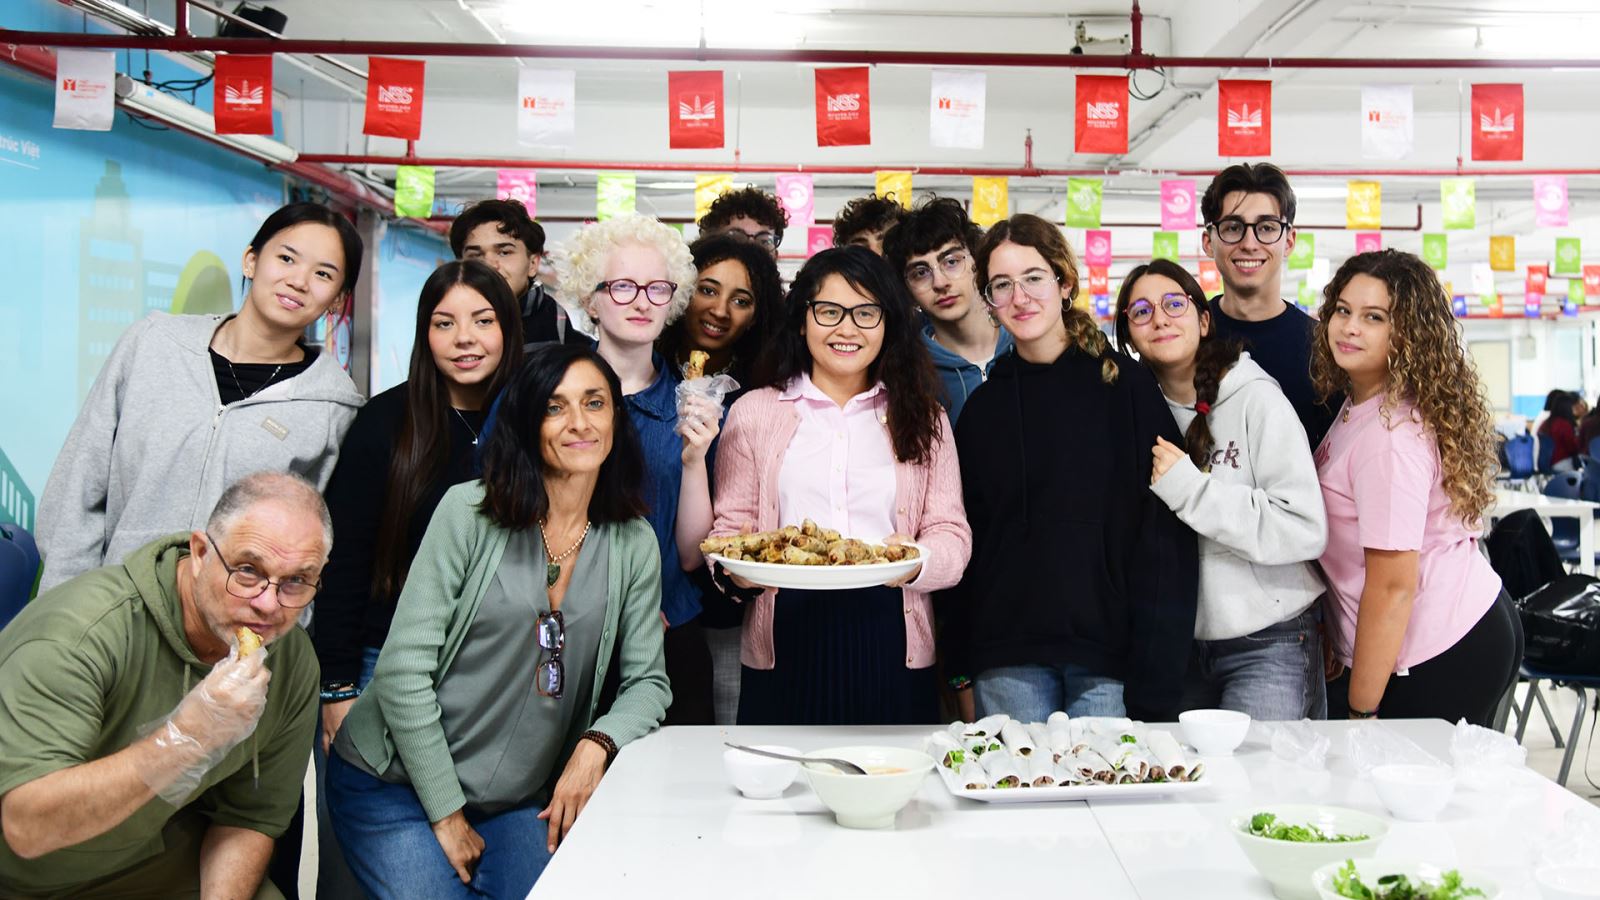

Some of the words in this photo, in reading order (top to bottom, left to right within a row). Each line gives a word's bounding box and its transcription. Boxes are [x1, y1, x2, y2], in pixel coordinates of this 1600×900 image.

[378, 85, 413, 104] NSS
[827, 93, 860, 111] NSS
[1086, 102, 1119, 119] NSS
[1207, 440, 1241, 469] ck
